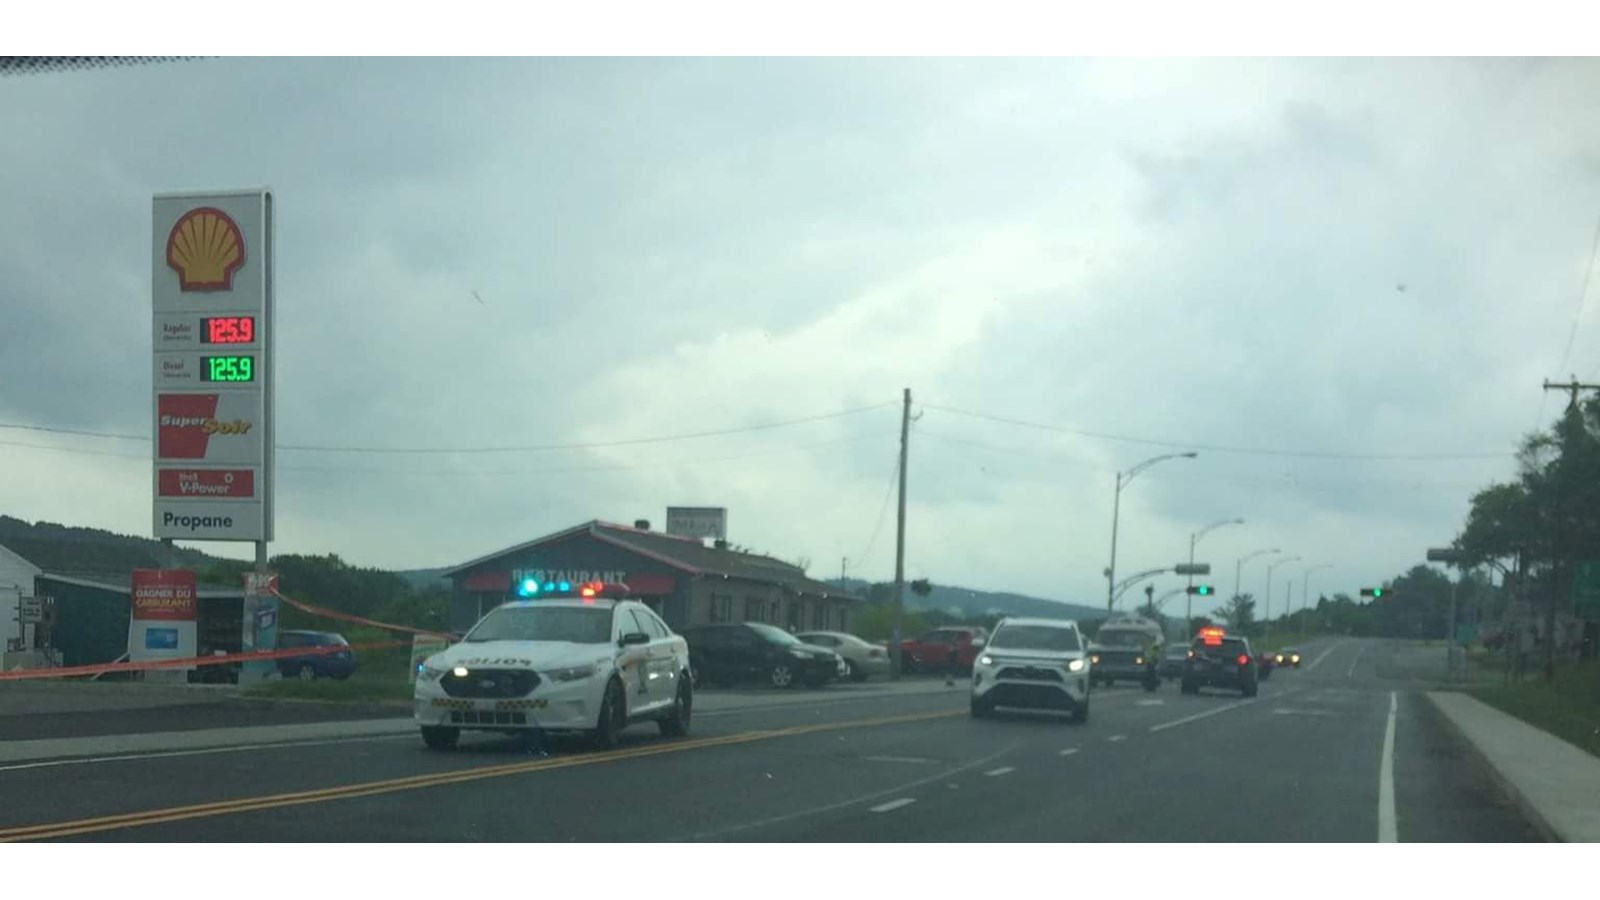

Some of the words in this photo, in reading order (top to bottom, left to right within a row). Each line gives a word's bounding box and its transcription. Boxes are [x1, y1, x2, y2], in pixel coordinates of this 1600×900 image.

[208, 318, 252, 343] 125.9
[208, 357, 251, 381] 125.9
[160, 414, 206, 428] Super
[201, 419, 252, 436] Soir
[179, 481, 231, 495] V-Power
[163, 511, 233, 532] Propane
[512, 568, 627, 584] RESTAURANT
[176, 589, 191, 598] DU
